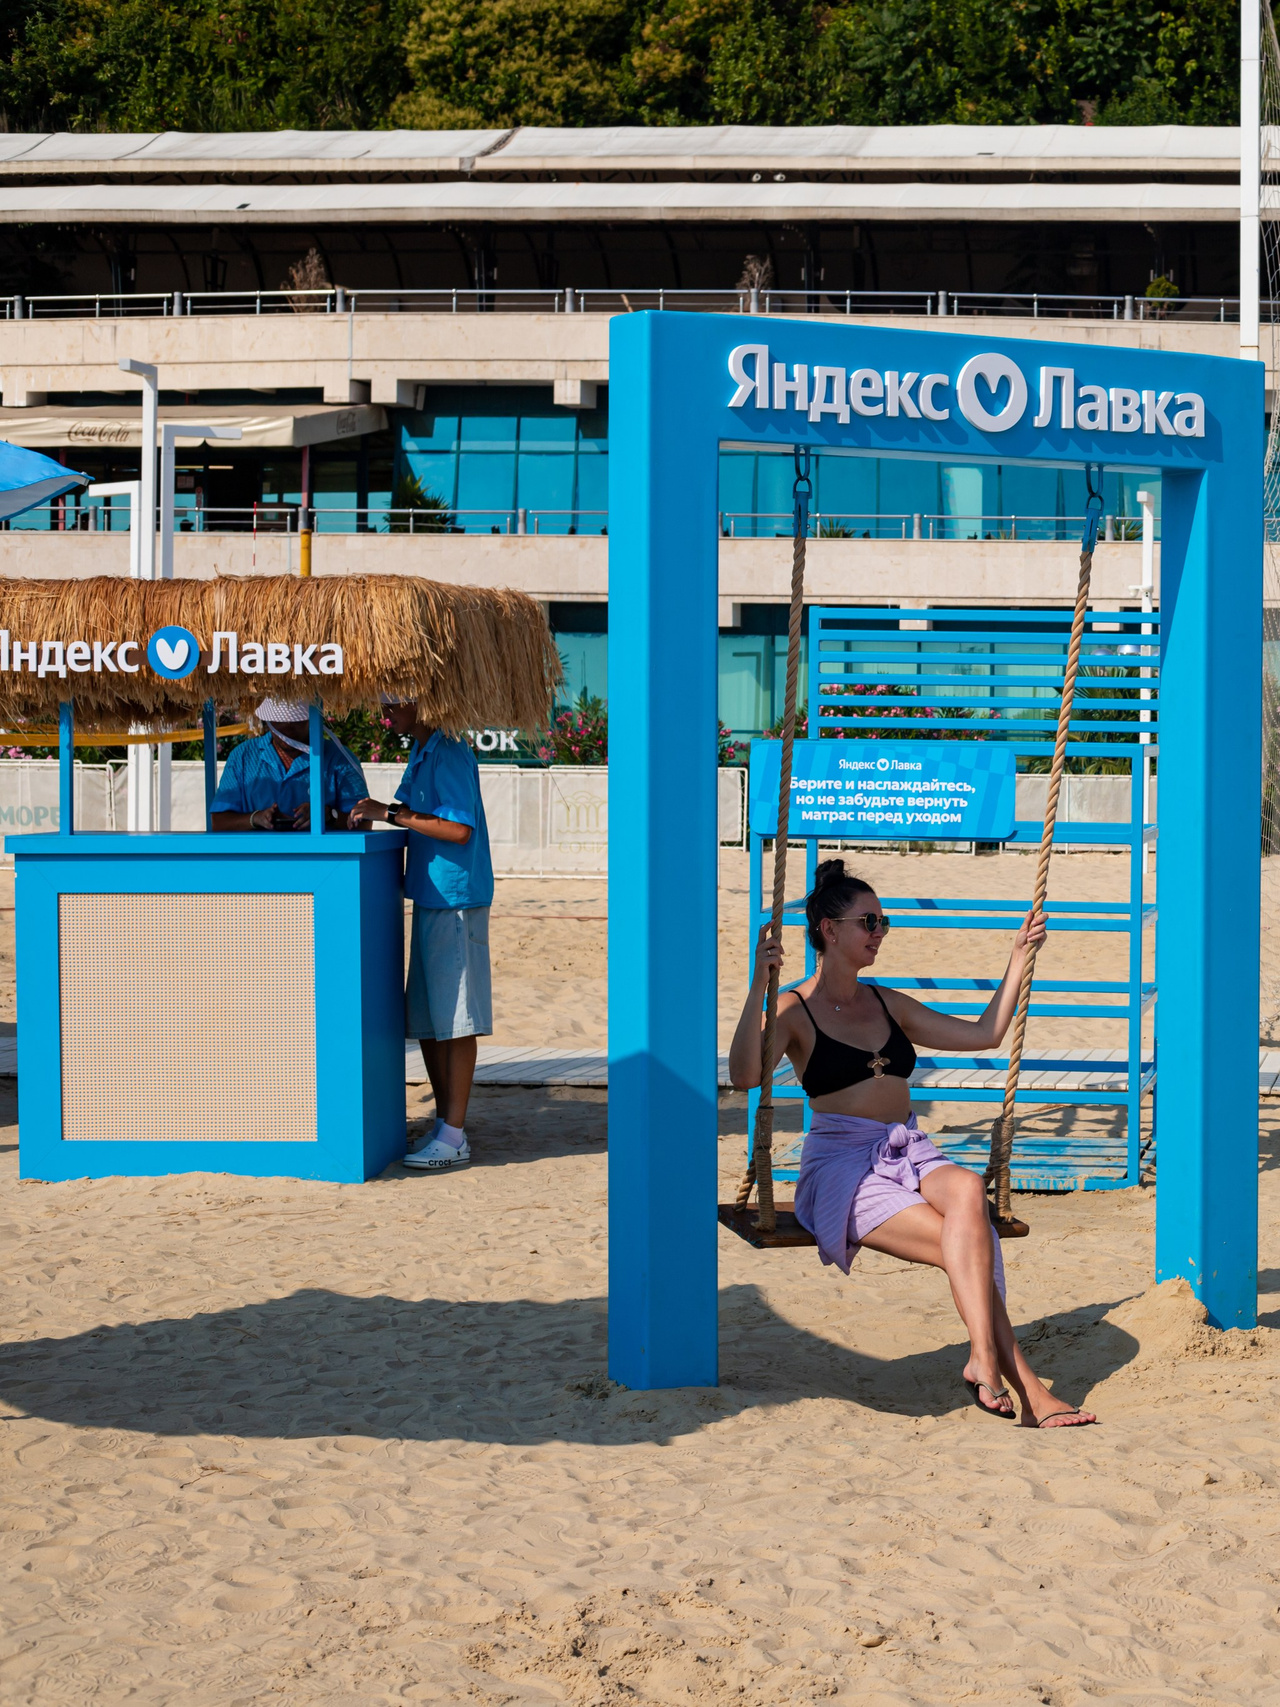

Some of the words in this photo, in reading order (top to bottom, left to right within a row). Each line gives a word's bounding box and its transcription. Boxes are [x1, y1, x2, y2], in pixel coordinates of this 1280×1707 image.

[727, 344, 950, 424] Яндекс
[1033, 366, 1206, 438] Лавка
[207, 631, 344, 676] Лавка
[839, 759, 875, 771] Яндекс
[891, 760, 922, 771] Лавка
[790, 777, 842, 790] Берите
[845, 780, 855, 789] и
[857, 778, 976, 794] наслаждайтесь,
[796, 795, 814, 805] но
[817, 796, 835, 806] не
[838, 793, 904, 808] забудьте
[907, 798, 968, 808] вернуть
[801, 811, 855, 823] матрас
[857, 812, 904, 824] перед
[905, 814, 962, 824] уходом
[428, 1159, 452, 1167] crocs
